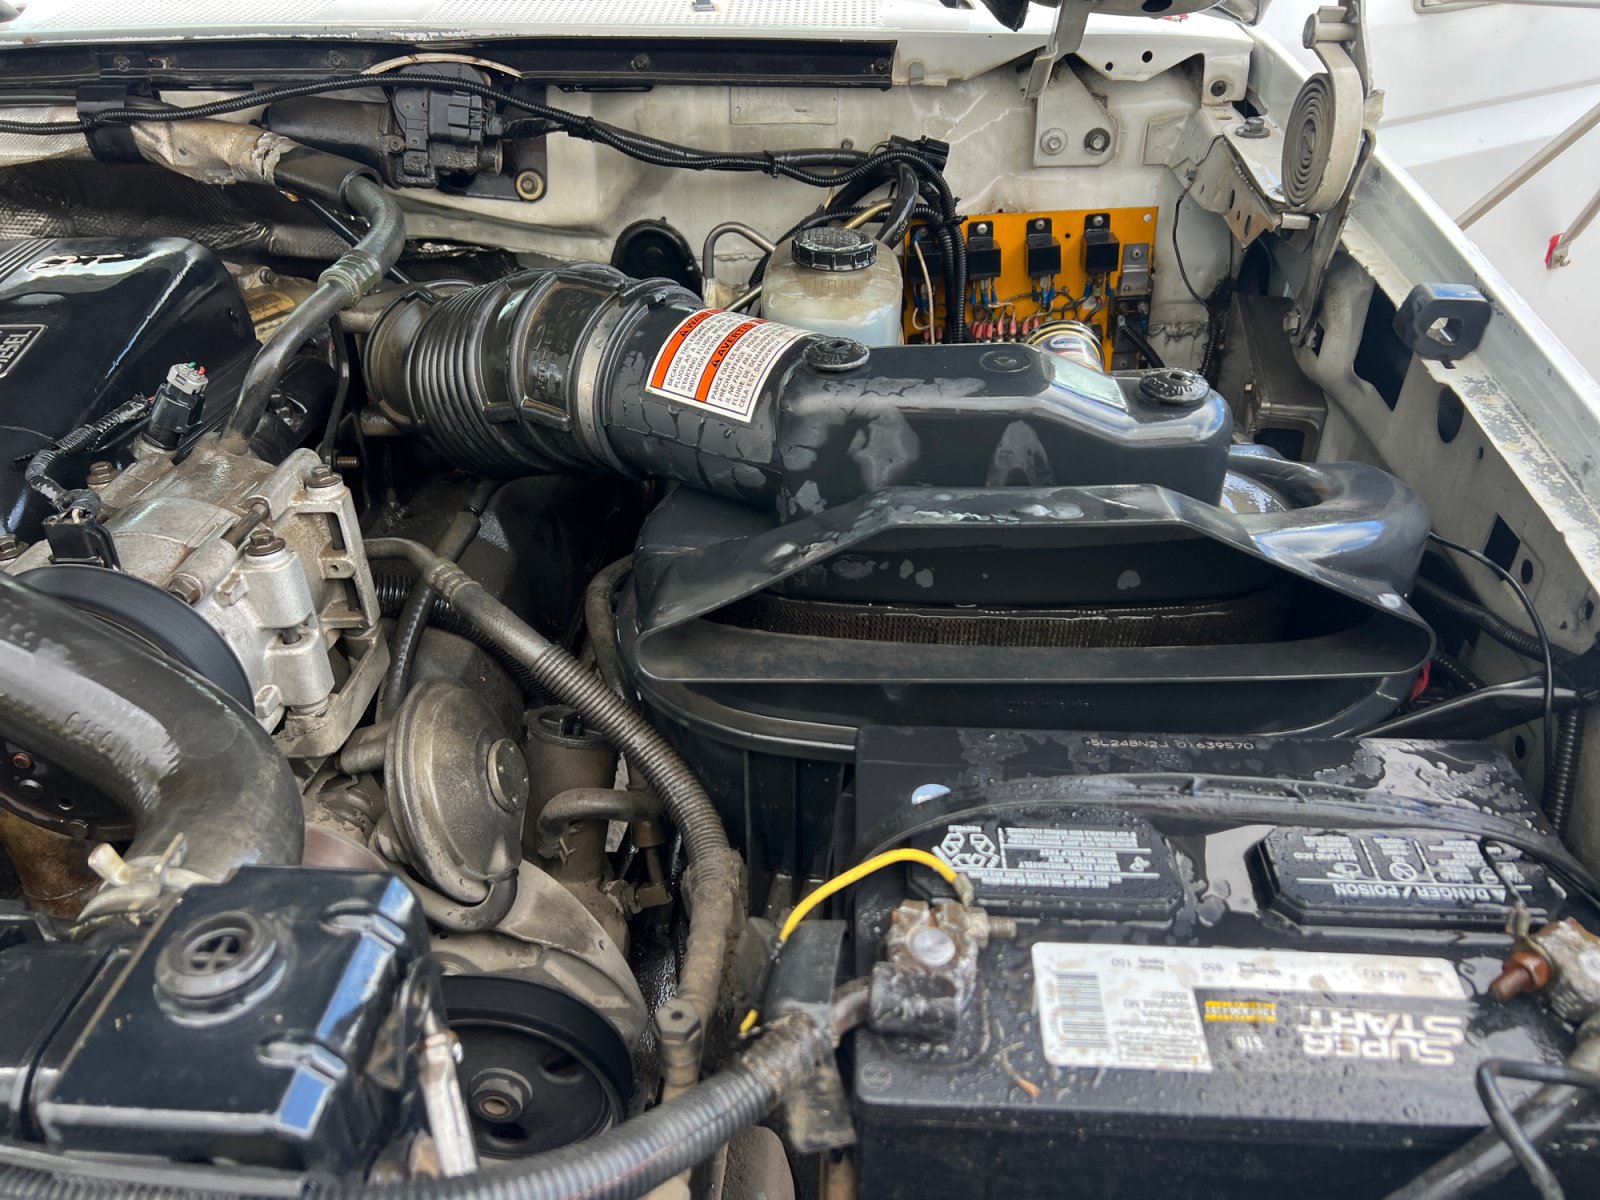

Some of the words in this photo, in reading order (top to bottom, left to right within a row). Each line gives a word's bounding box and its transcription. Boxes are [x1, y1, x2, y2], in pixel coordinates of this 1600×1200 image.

[667, 356, 682, 386] BECAUSE
[674, 364, 686, 388] PLUGS
[684, 353, 692, 363] AS
[681, 357, 698, 390] STARTING
[696, 335, 713, 354] FLUIDS
[687, 356, 707, 392] INDUCTION
[711, 376, 723, 400] PARCE
[721, 362, 731, 375] QUE
[729, 352, 737, 361] CE
[728, 384, 736, 395] NE
[733, 366, 744, 383] FAUT
[742, 353, 753, 365] PAS
[731, 382, 745, 406] FLUIDE
[742, 369, 751, 379] DE
[739, 385, 751, 408] CELA
[1332, 883, 1400, 897] POISON
[1414, 886, 1490, 900] DANGER
[1297, 1011, 1465, 1046] START
[1302, 1034, 1456, 1067] SUPER
